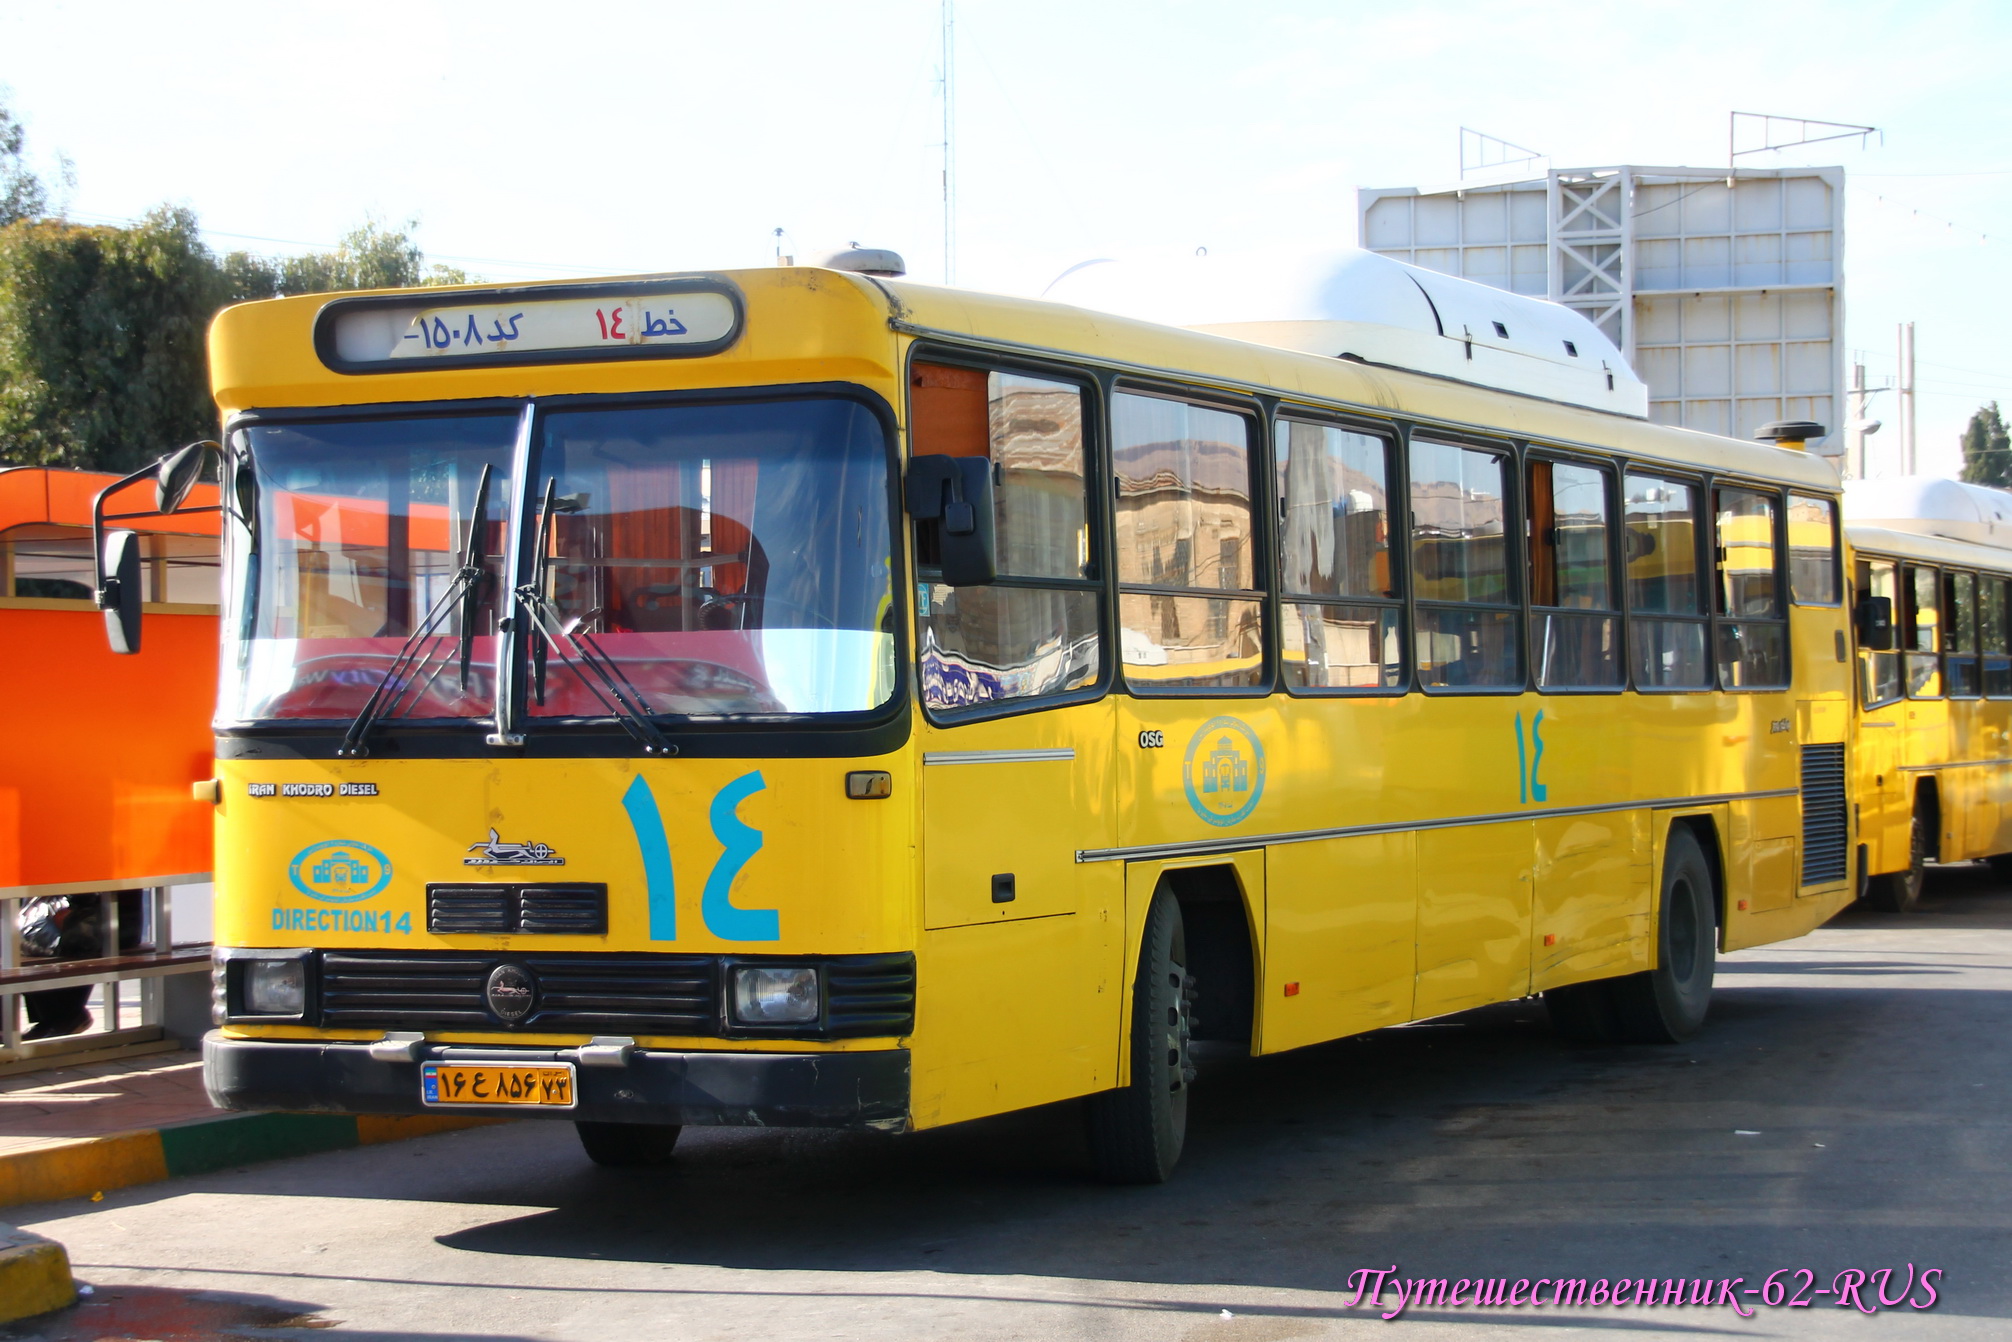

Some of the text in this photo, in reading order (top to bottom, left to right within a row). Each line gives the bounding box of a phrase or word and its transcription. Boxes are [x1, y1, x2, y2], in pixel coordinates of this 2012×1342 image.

[641, 309, 688, 337] خط
[1139, 730, 1164, 749] OSG
[248, 782, 380, 799] IRAN KHODRO DIESEL
